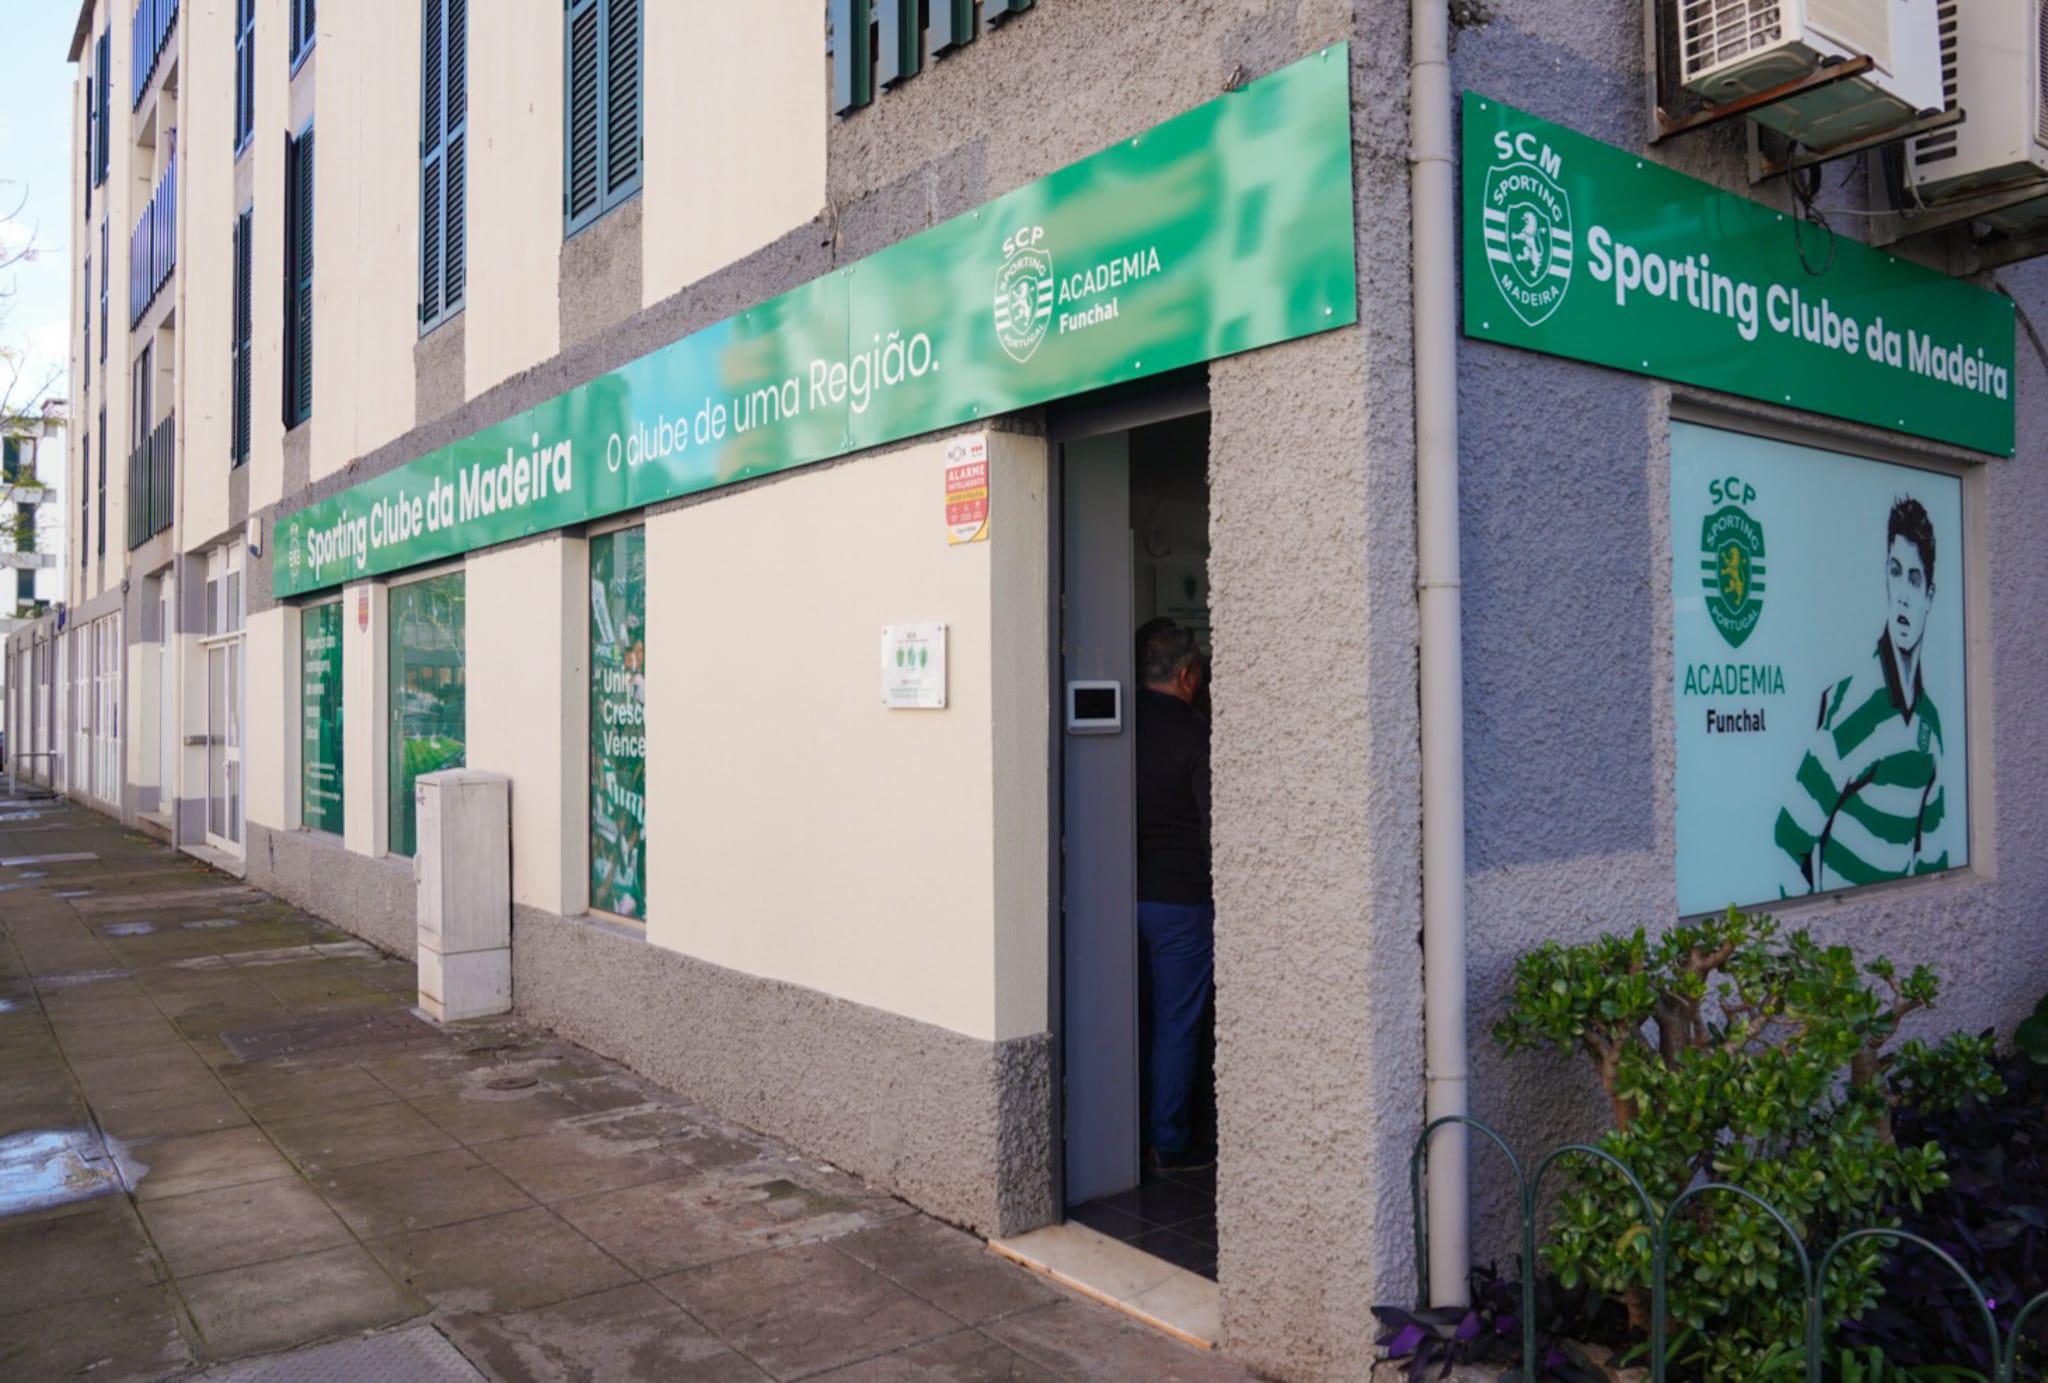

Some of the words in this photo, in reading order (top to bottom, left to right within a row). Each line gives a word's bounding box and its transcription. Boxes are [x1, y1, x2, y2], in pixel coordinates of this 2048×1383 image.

[1494, 130, 1562, 180] SCM
[1493, 174, 1563, 222] SPORTING
[1002, 225, 1044, 259] SCP
[1000, 256, 1047, 291] SPORTING
[1057, 246, 1161, 305] ACADEMIA
[1501, 273, 1560, 307] MADEIRA
[1059, 297, 1119, 335] Funchal
[1587, 224, 1759, 342] Sporting
[1766, 283, 1860, 354] Clube
[1865, 316, 1902, 368] da
[1907, 328, 2007, 400] Madeira
[607, 432, 622, 473] O
[626, 416, 688, 467] clube
[694, 396, 727, 445] de
[733, 377, 801, 433] uma
[808, 329, 940, 413] Região.
[948, 463, 985, 480] ALARME
[307, 509, 367, 581] Sporting
[370, 490, 423, 549] Clube
[426, 475, 454, 533] da
[459, 431, 572, 523] Madeira
[1708, 476, 1757, 504] SCP
[1706, 515, 1761, 551] SPORTING
[1711, 605, 1759, 632] PORTUGAL
[1683, 663, 1786, 696] ACADEMIA
[603, 699, 646, 725] Cresc
[1706, 708, 1766, 734] Funchal
